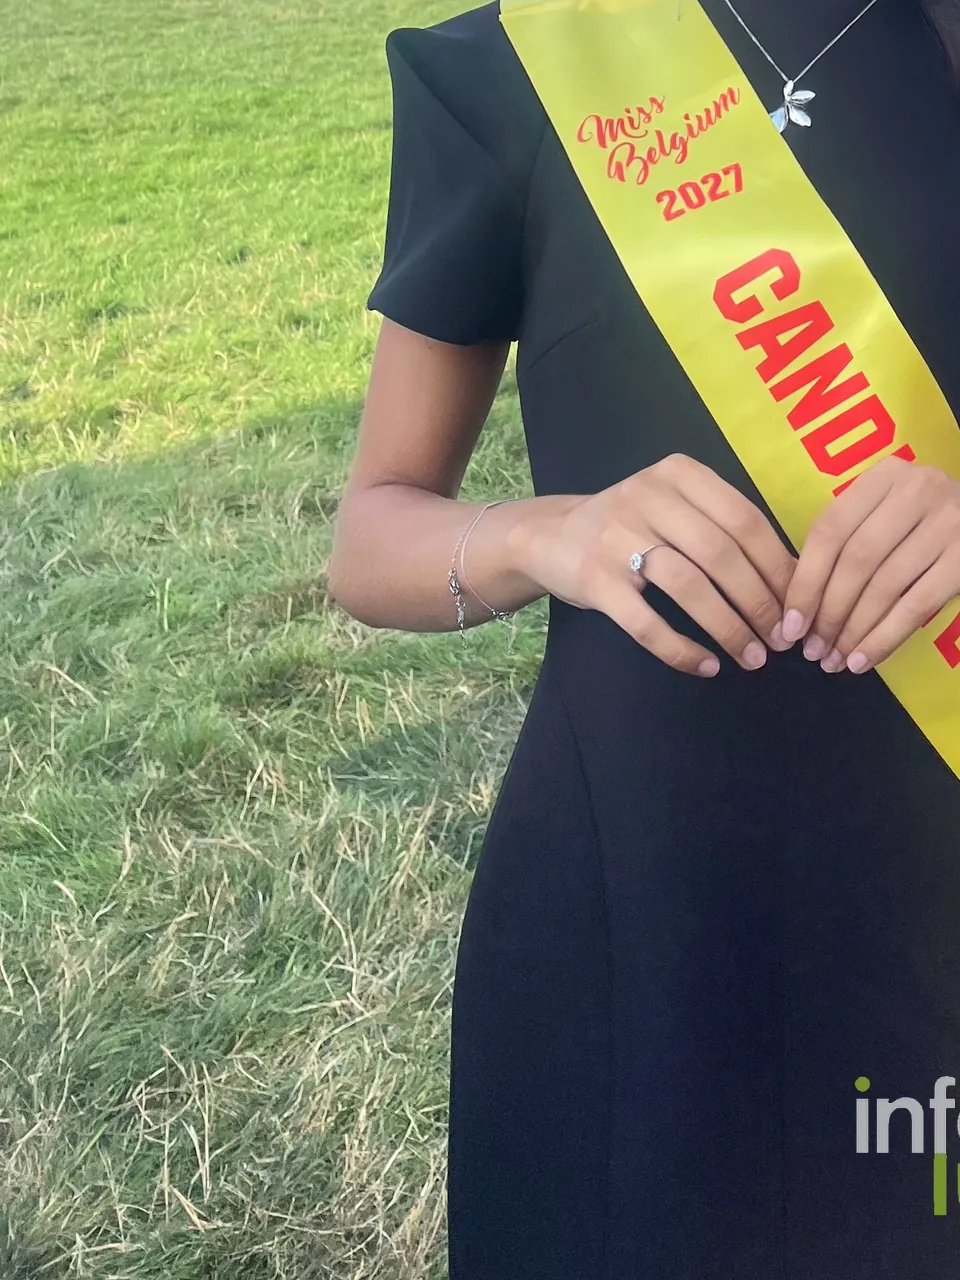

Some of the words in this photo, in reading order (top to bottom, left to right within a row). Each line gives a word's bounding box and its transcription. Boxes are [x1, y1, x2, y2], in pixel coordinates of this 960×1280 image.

[576, 94, 665, 149] Miss
[606, 87, 740, 185] Belgium
[655, 162, 744, 222] 2027
